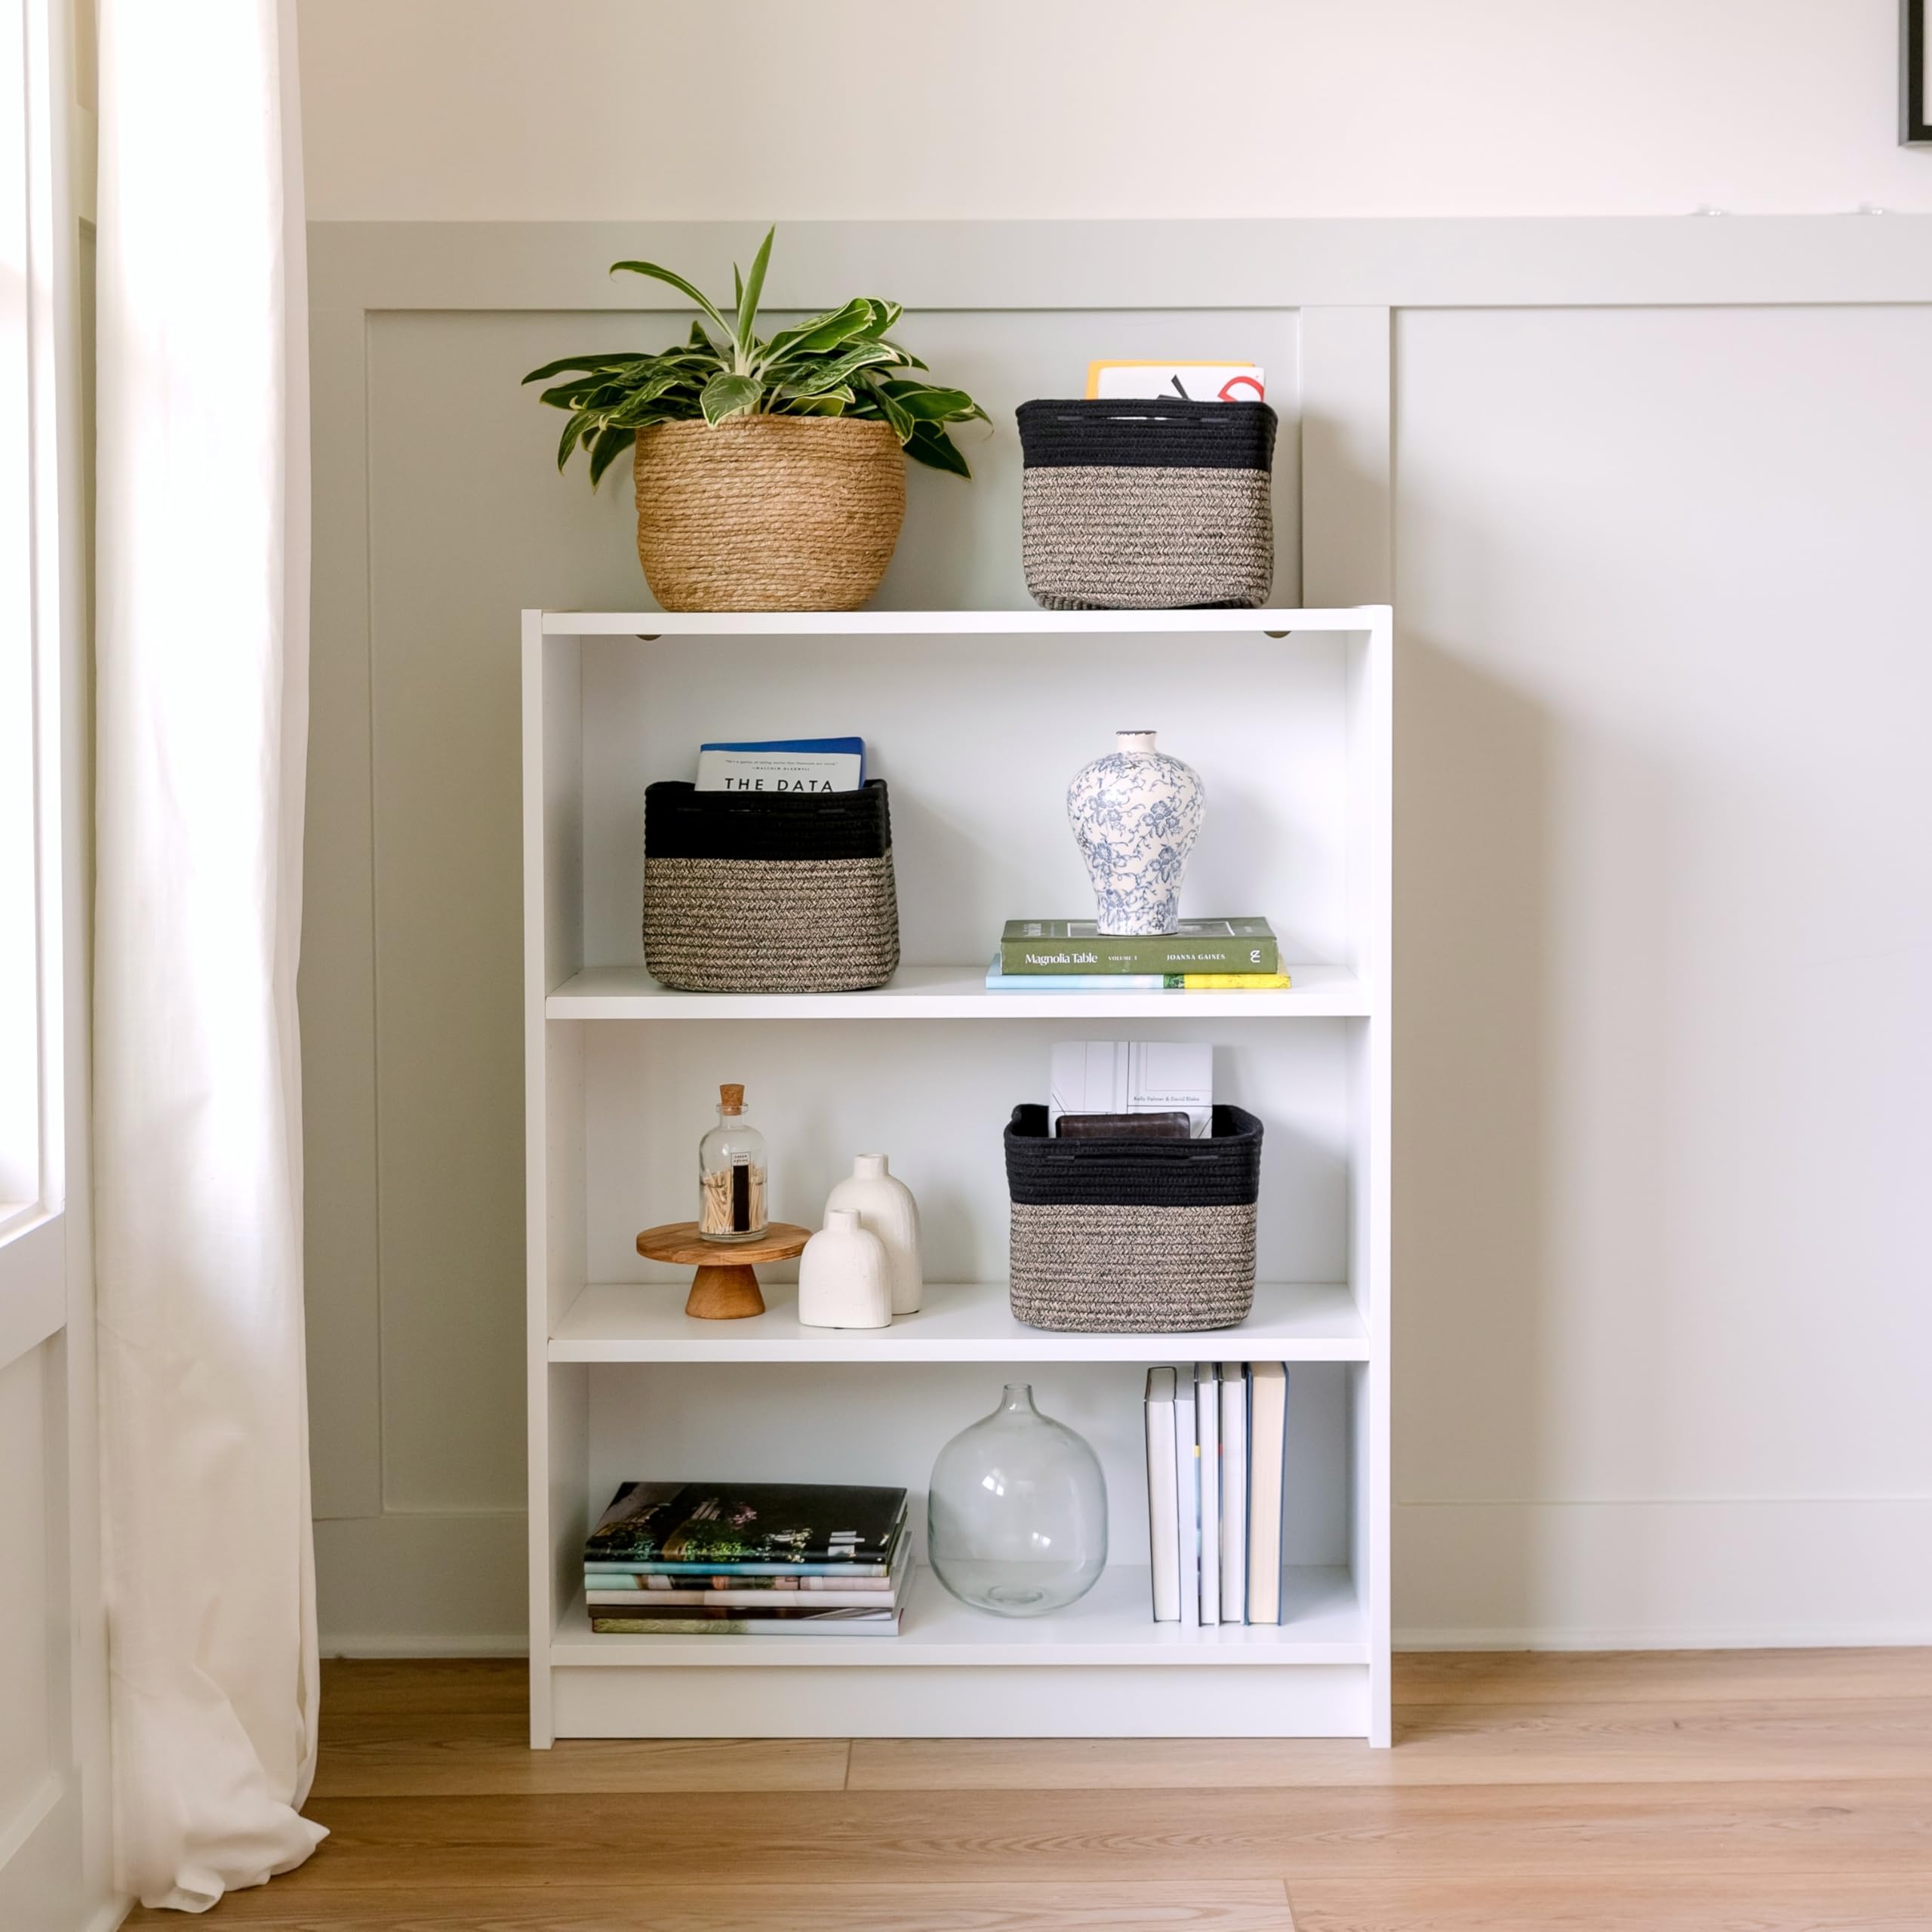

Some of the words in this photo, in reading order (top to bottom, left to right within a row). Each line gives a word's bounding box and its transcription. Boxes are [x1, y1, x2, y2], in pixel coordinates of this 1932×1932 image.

[724, 777, 764, 791] THE
[777, 779, 833, 792] DATA
[1025, 952, 1070, 966] Magnolia
[1072, 952, 1099, 964] Table
